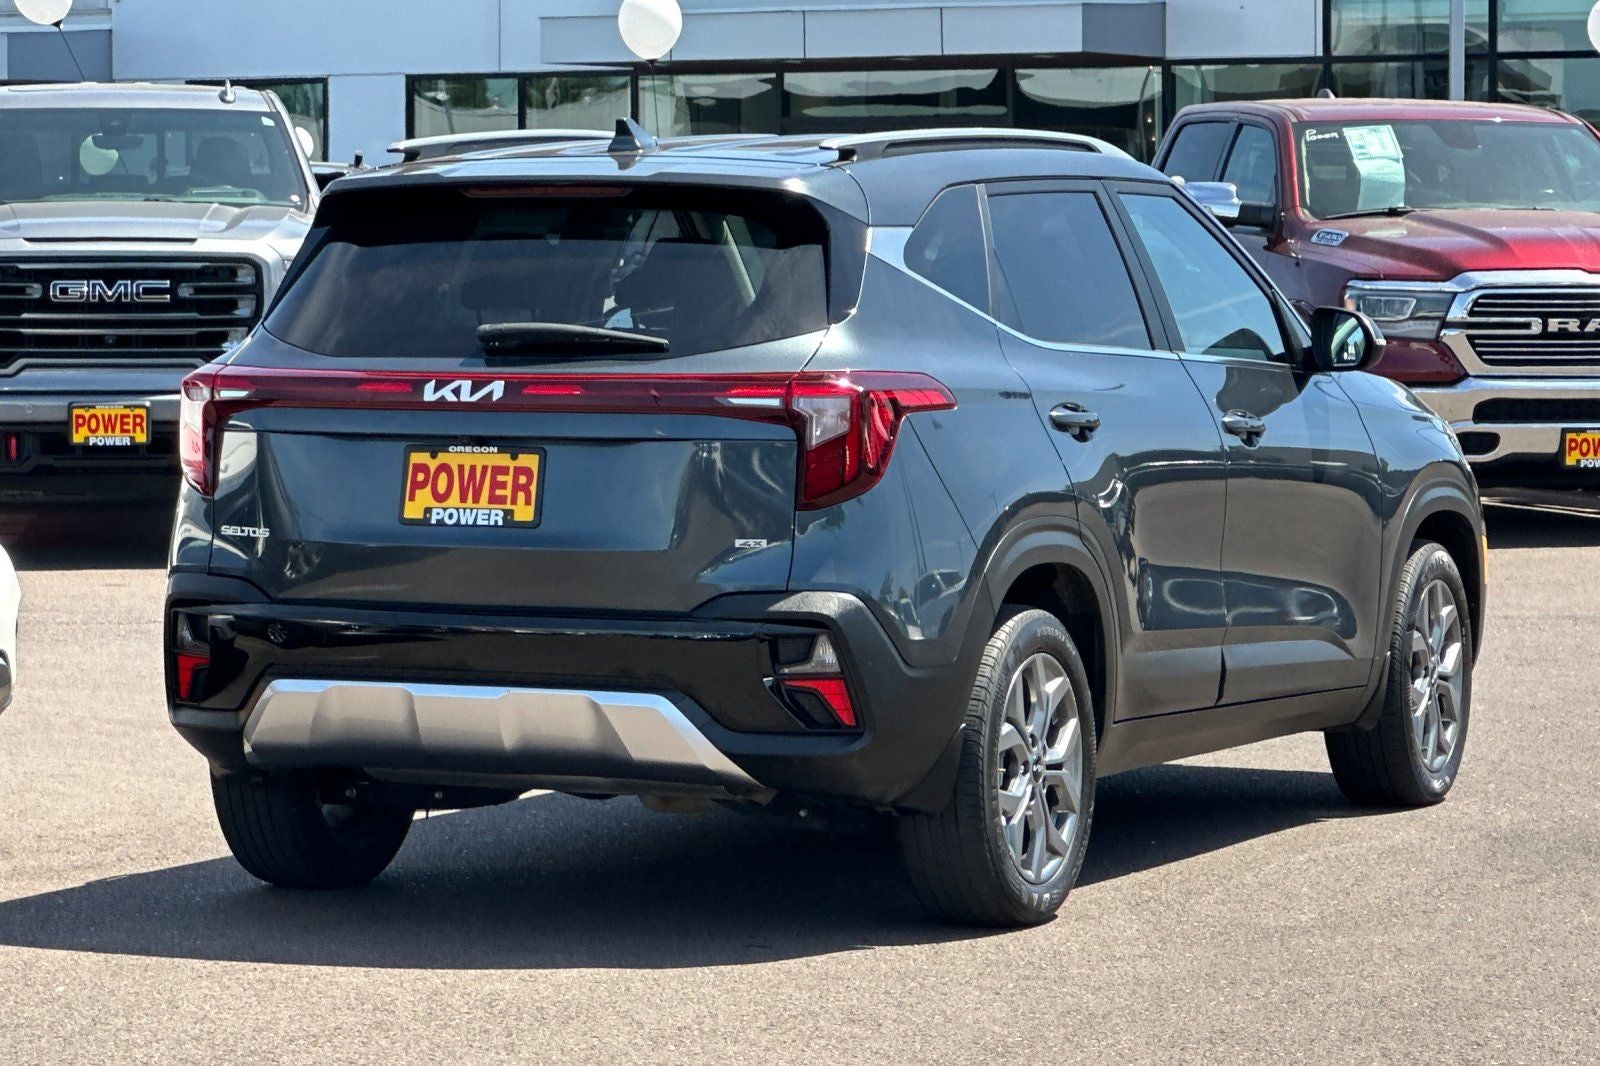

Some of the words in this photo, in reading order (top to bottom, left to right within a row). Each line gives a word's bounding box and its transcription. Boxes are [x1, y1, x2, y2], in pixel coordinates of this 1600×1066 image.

[50, 279, 171, 302] GMC
[423, 379, 505, 402] KIA
[74, 413, 145, 434] POWER
[89, 436, 130, 446] POWER
[448, 445, 498, 453] OREGON
[408, 462, 534, 506] POWER
[430, 508, 504, 526] POWER
[221, 525, 270, 538] SELTOS
